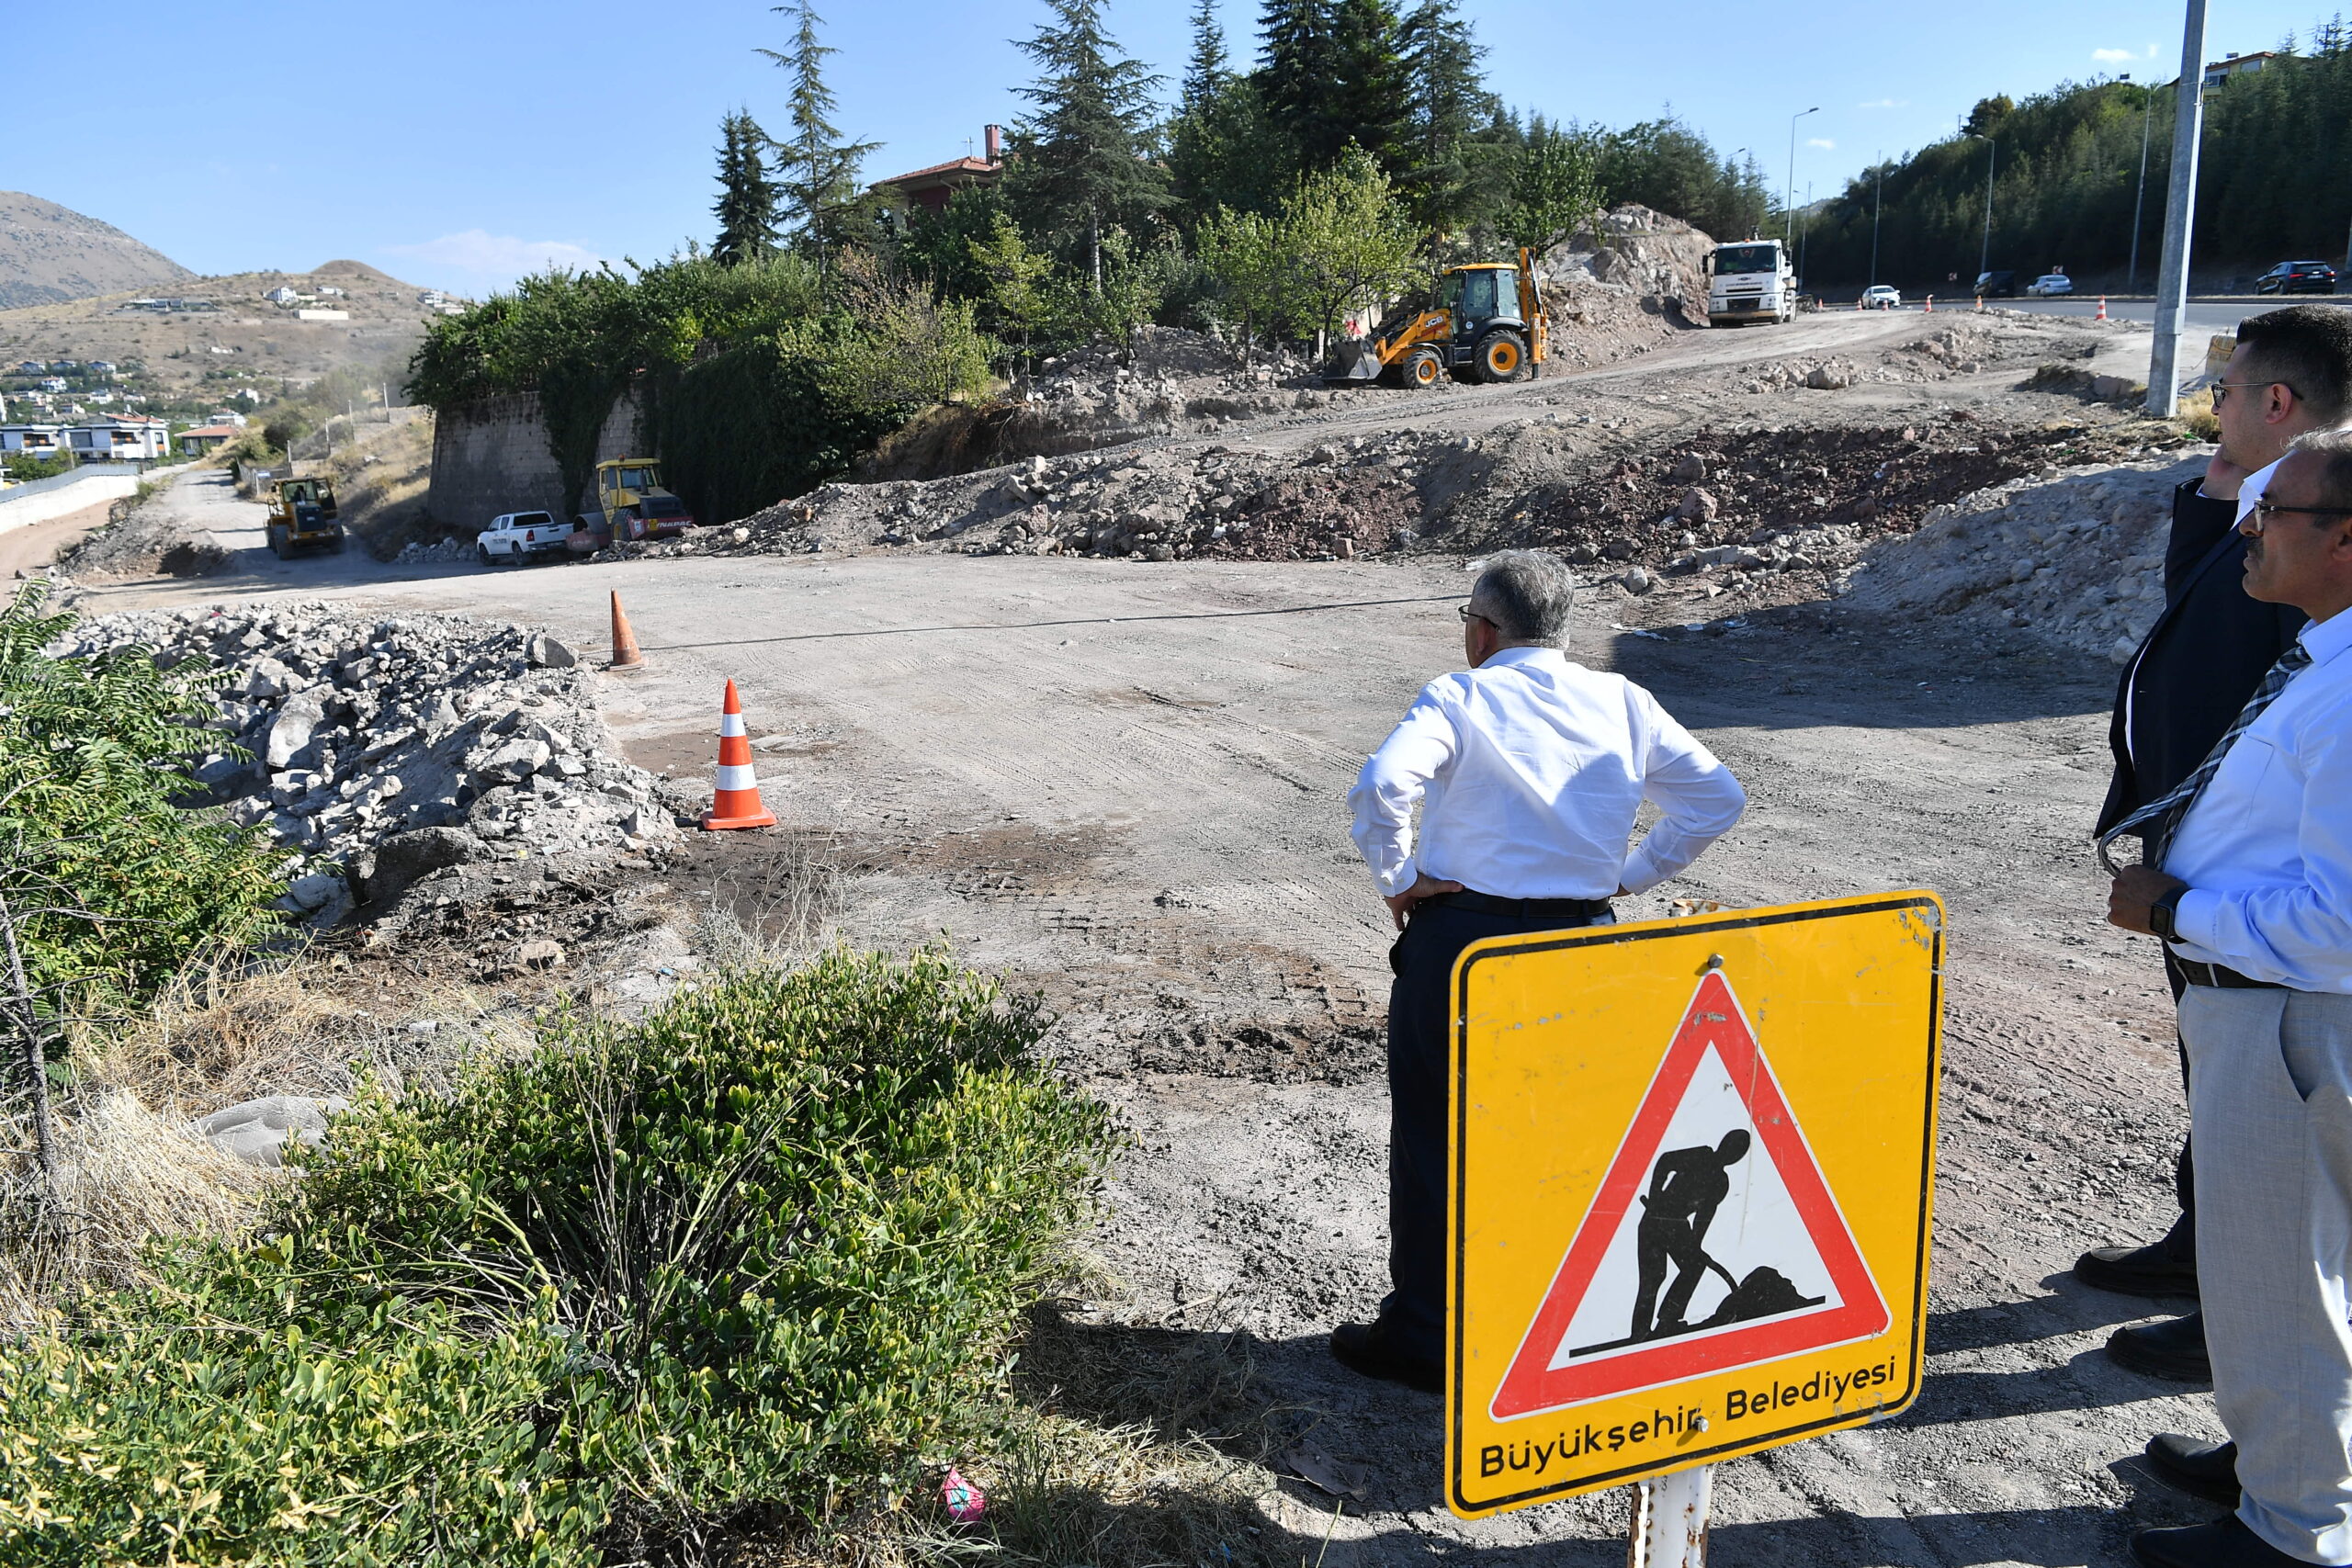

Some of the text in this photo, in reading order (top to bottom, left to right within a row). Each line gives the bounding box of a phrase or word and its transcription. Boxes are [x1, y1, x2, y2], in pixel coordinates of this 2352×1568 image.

[1425, 316, 1443, 328] JCB
[1481, 1355, 1895, 1478] Büyükşehir Belediyesi
